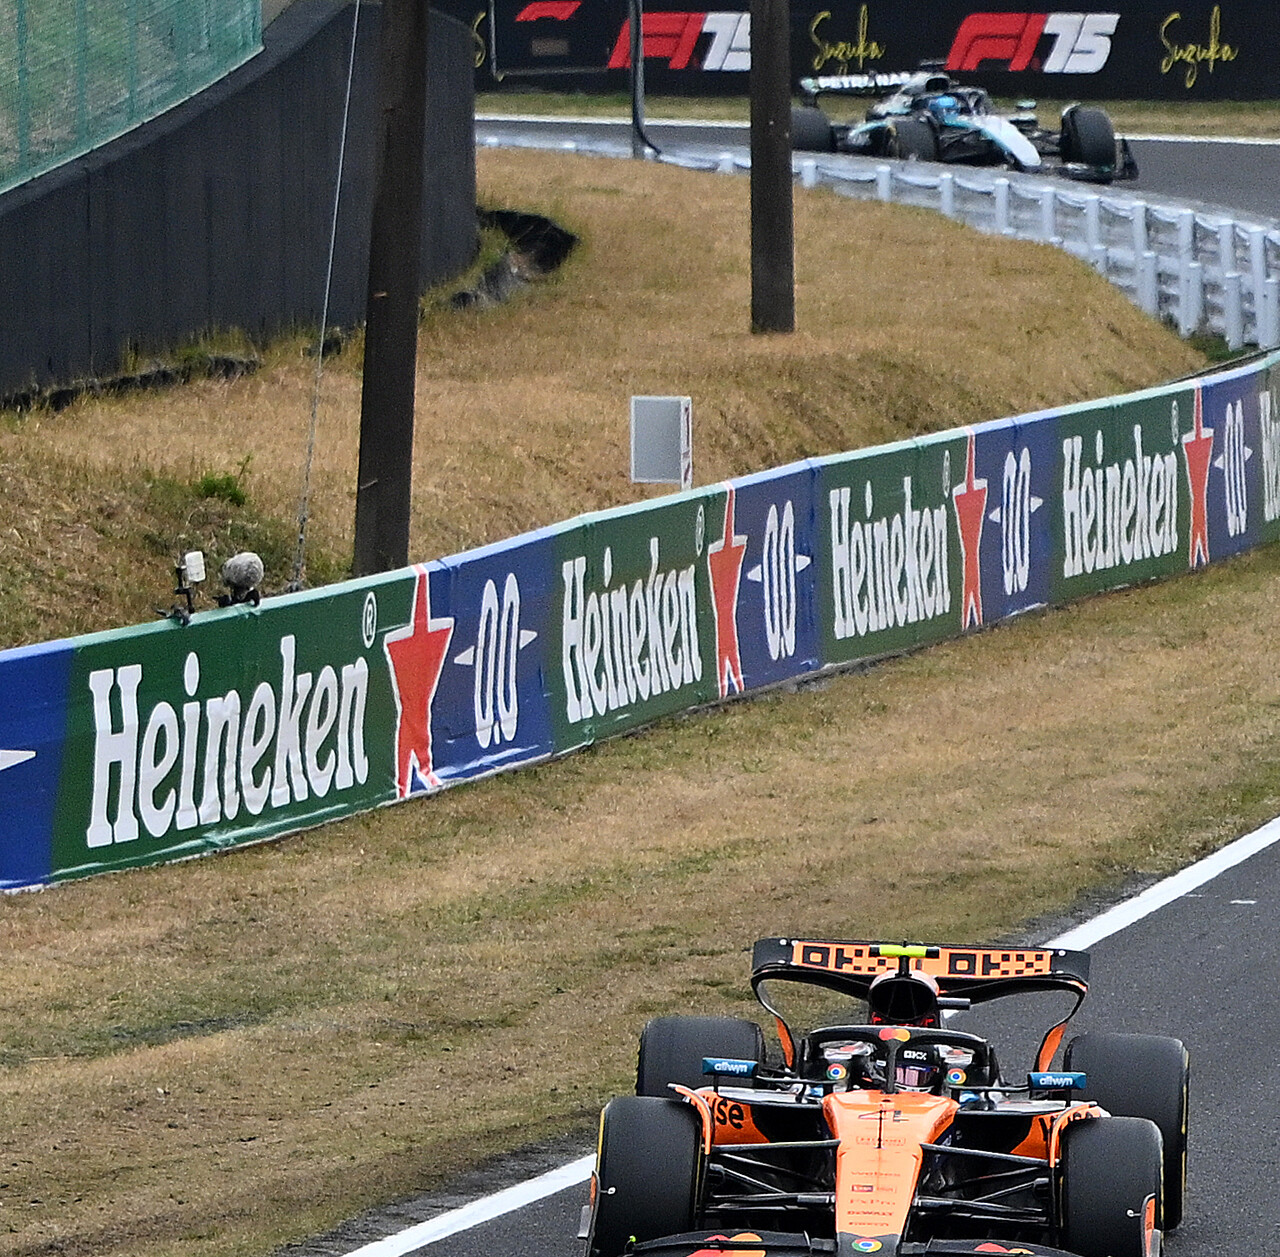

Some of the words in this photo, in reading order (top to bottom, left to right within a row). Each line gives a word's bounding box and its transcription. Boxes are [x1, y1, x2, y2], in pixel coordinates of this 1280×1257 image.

[1043, 12, 1121, 73] 75
[1159, 5, 1239, 88] Suzuka
[829, 476, 950, 639] Heineken
[1062, 424, 1178, 578] Heineken
[474, 573, 520, 749] 0.0
[562, 537, 702, 724] Heineken
[87, 635, 370, 848] Heineken
[714, 1061, 748, 1074] allwyn
[1040, 1075, 1073, 1087] allwyn
